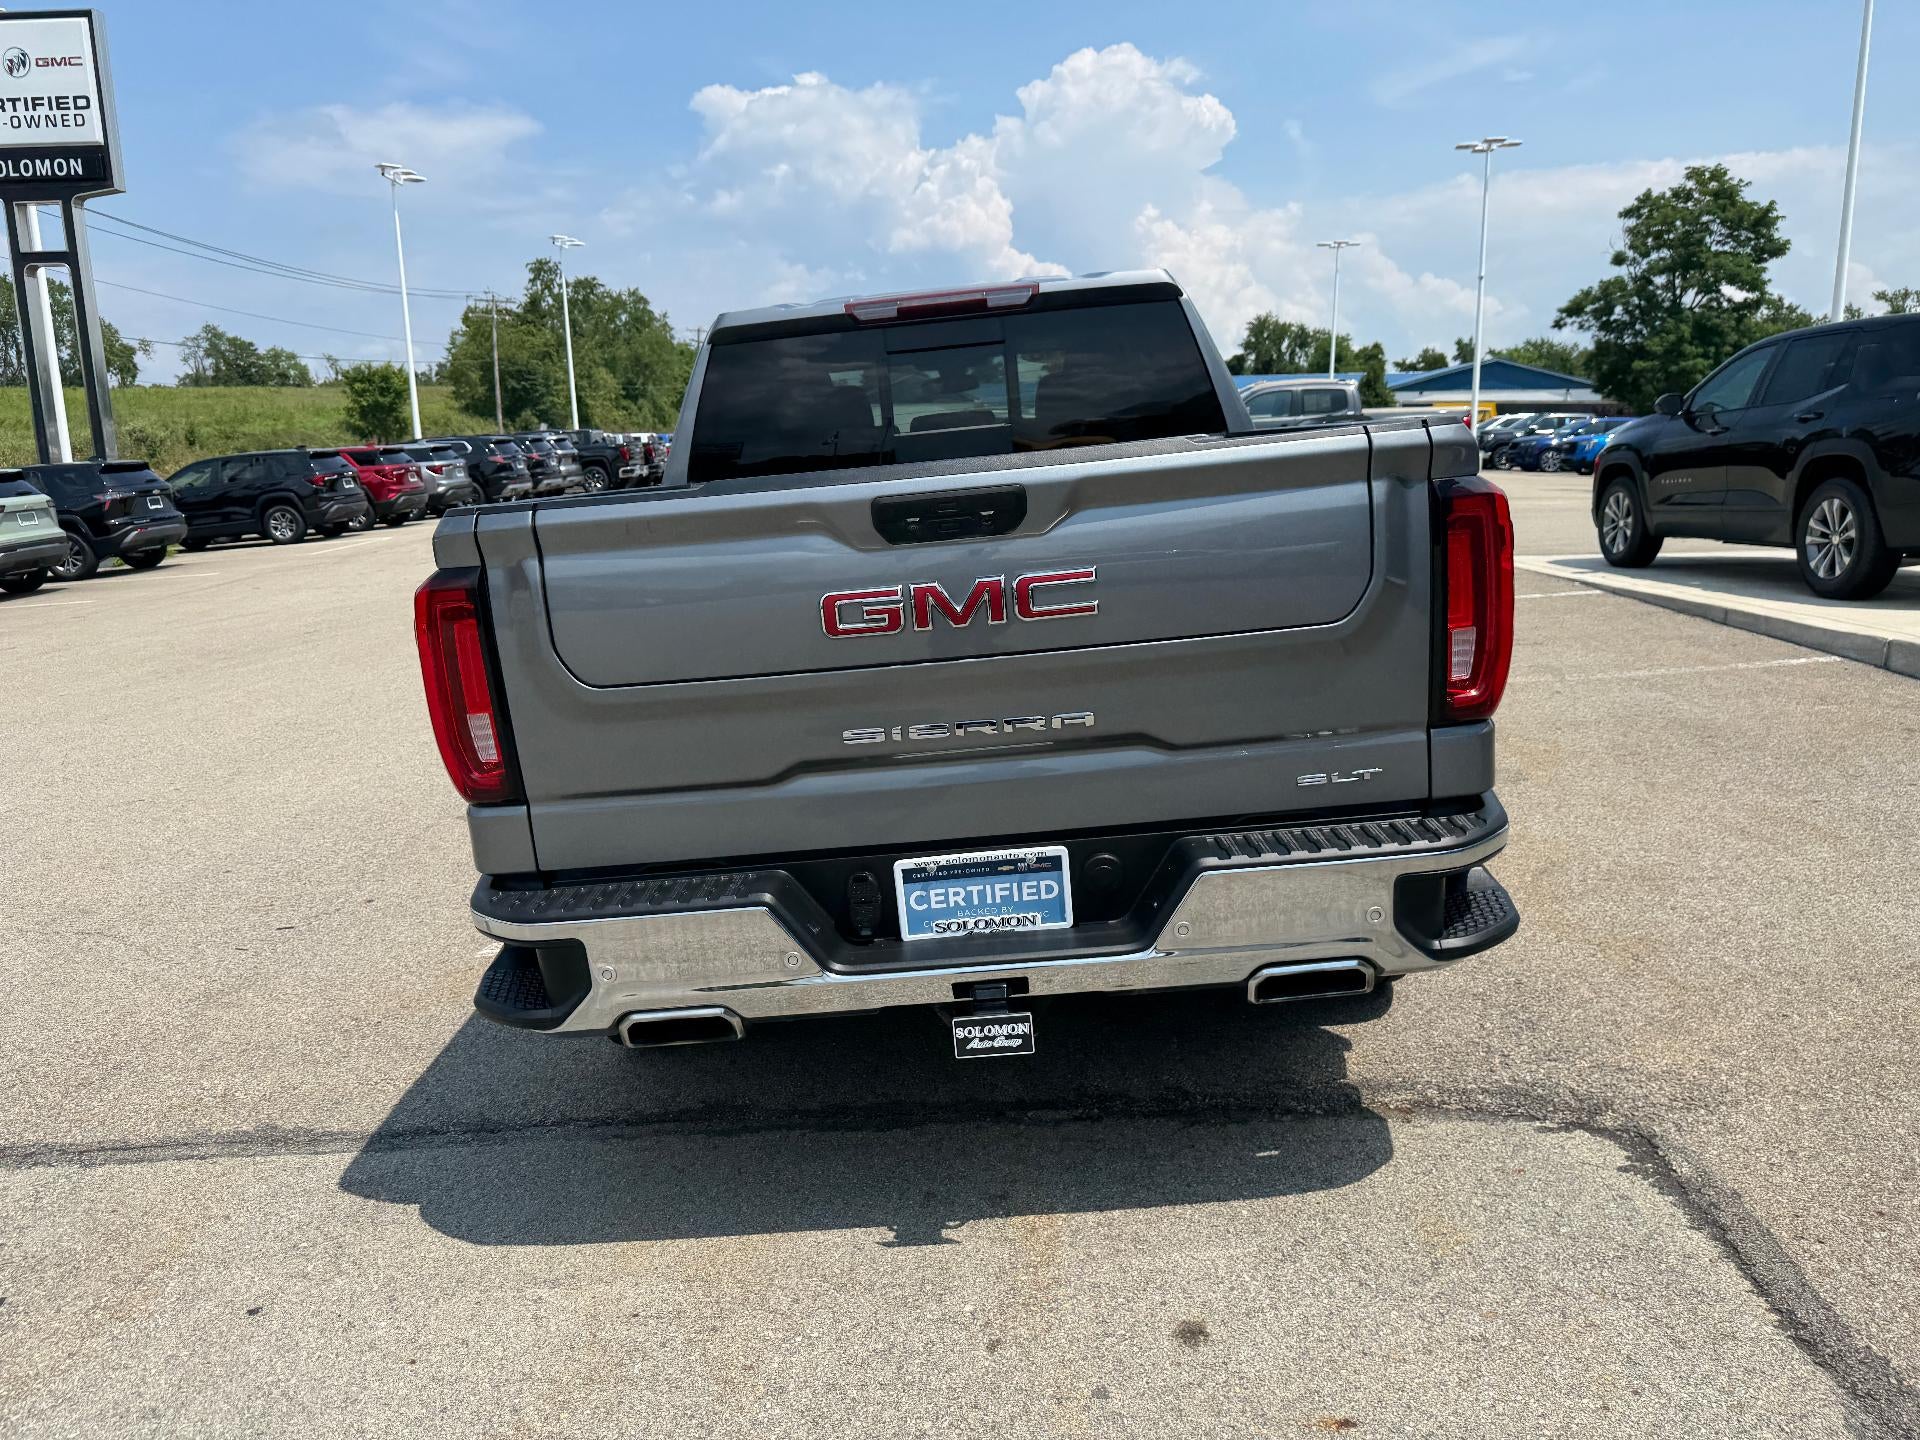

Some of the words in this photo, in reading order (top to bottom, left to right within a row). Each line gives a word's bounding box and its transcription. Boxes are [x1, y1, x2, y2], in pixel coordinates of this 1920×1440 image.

[35, 56, 83, 68] GMC
[820, 565, 1099, 639] GMC
[842, 711, 1095, 745] SIERRA
[1297, 767, 1383, 786] SLT
[909, 879, 1059, 911] CERTIFIED
[957, 907, 998, 917] BACKED
[1001, 905, 1014, 913] BY
[934, 915, 1038, 934] SOLOMON
[955, 1022, 1031, 1039] SOLOMON
[966, 1038, 993, 1050] Auto
[992, 1036, 1023, 1048] Group
